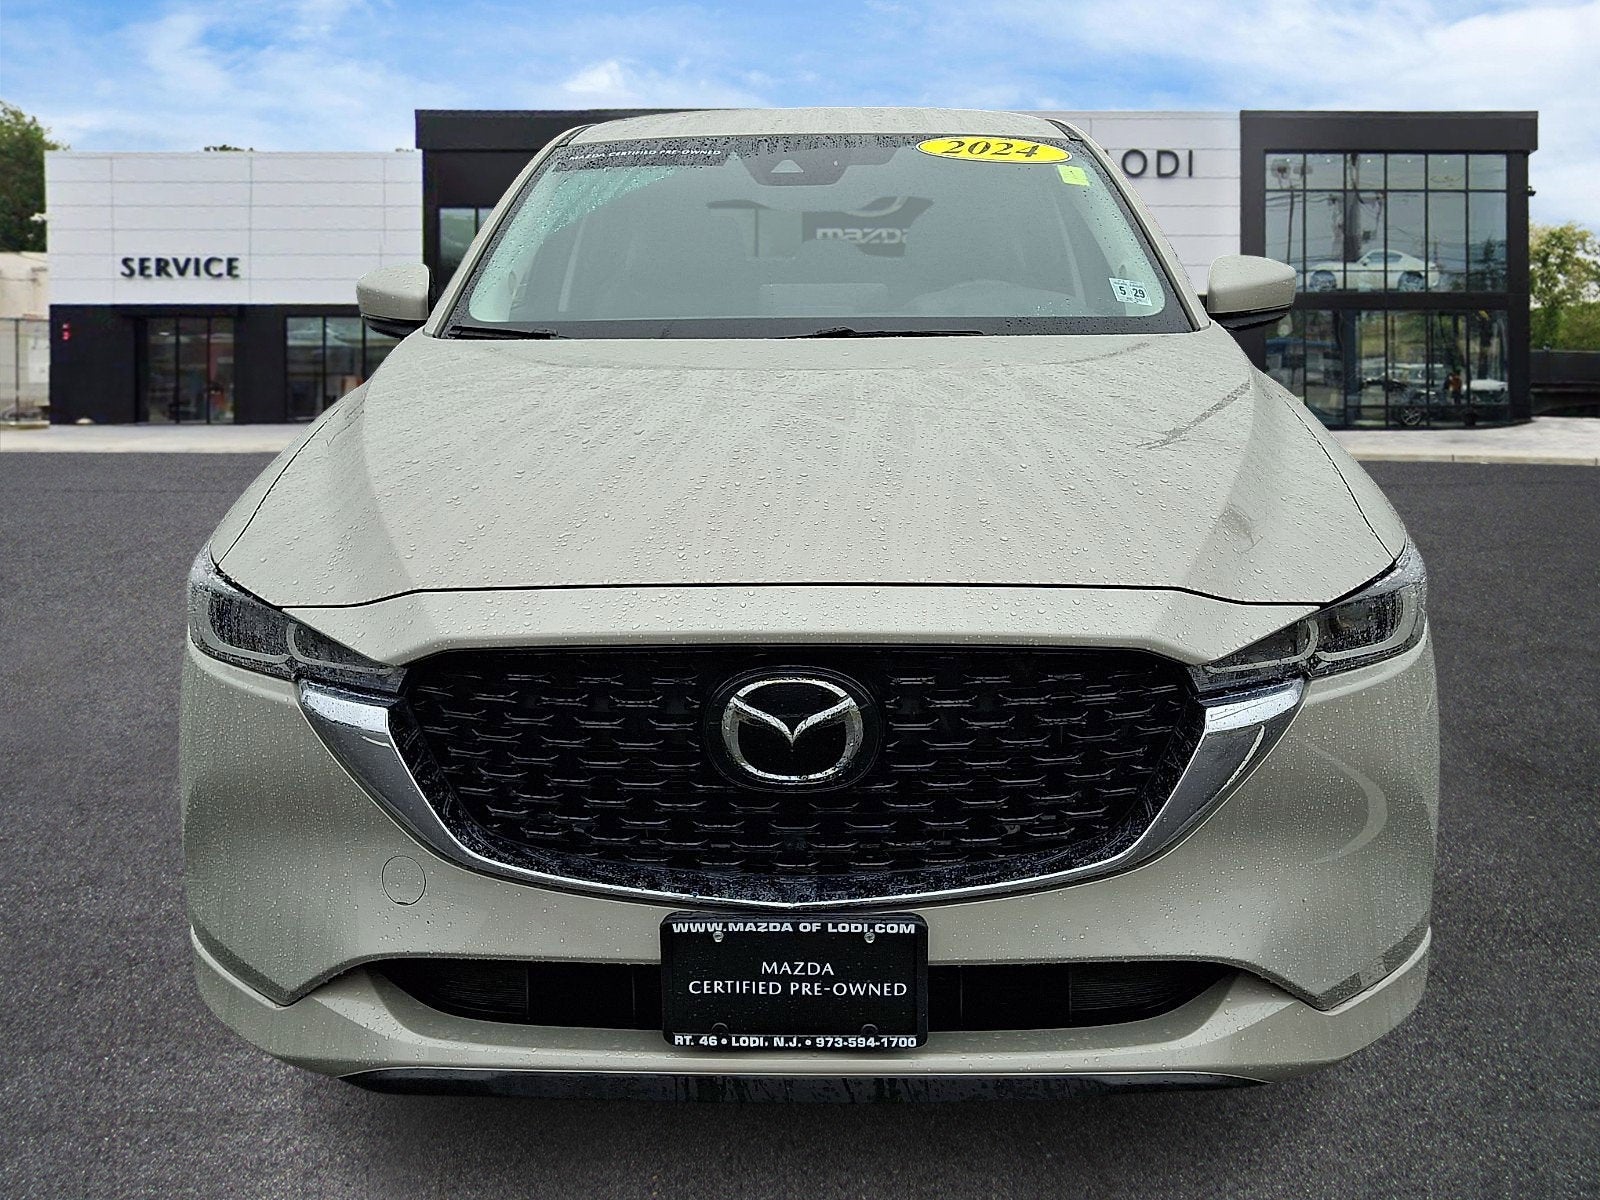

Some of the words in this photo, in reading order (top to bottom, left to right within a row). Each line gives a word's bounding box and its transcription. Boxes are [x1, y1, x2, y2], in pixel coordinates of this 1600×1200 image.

[942, 140, 1040, 158] 2024
[1105, 148, 1193, 178] ODI
[120, 257, 240, 278] SERVICE
[1118, 286, 1126, 296] 5
[1132, 288, 1146, 298] 29
[673, 923, 792, 934] WWW.MAZDA
[799, 923, 822, 933] OF
[828, 922, 916, 934] LODI.COM
[761, 961, 835, 976] MAZDA
[688, 980, 782, 995] CERTIFIED
[790, 982, 908, 997] PRE-OWNED
[674, 1035, 694, 1046] RT.
[699, 1035, 718, 1047] 46
[773, 1036, 802, 1048] N.J.
[815, 1037, 918, 1049] 973-594-1700
